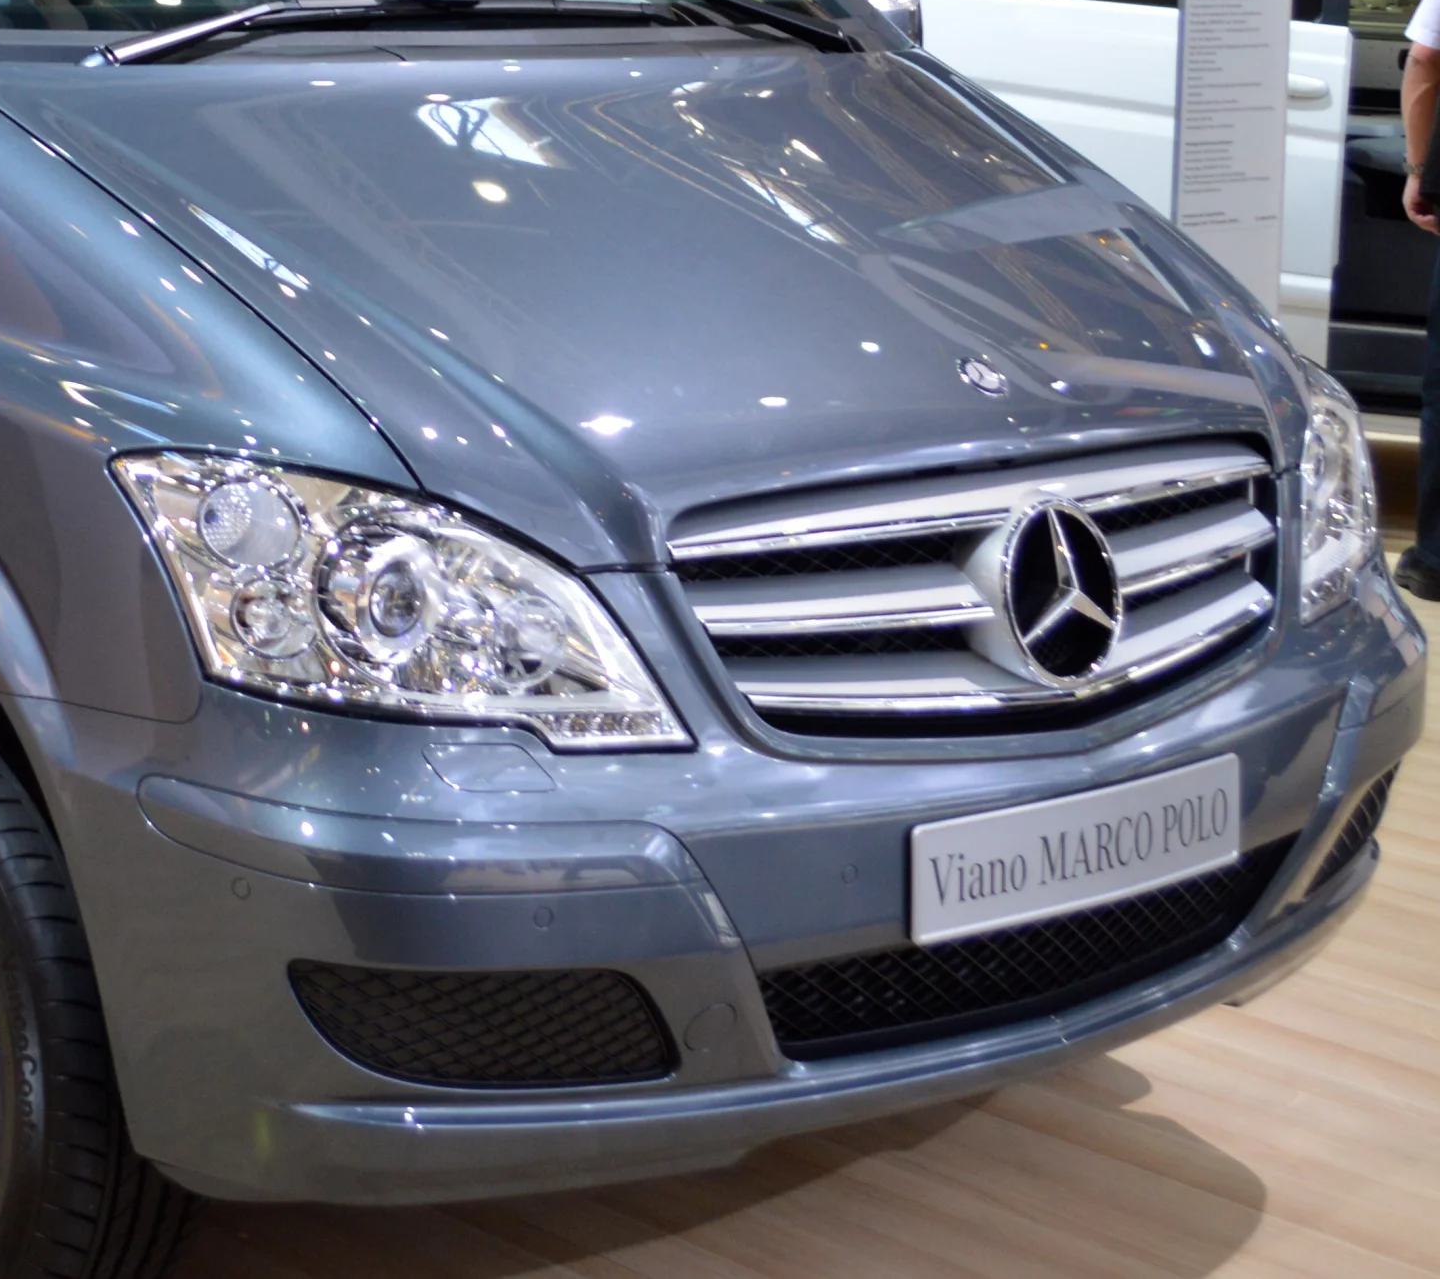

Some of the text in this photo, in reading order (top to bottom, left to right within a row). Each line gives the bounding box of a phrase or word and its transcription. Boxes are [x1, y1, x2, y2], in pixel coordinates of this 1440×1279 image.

[929, 788, 1228, 907] Viano MARCO POLO
